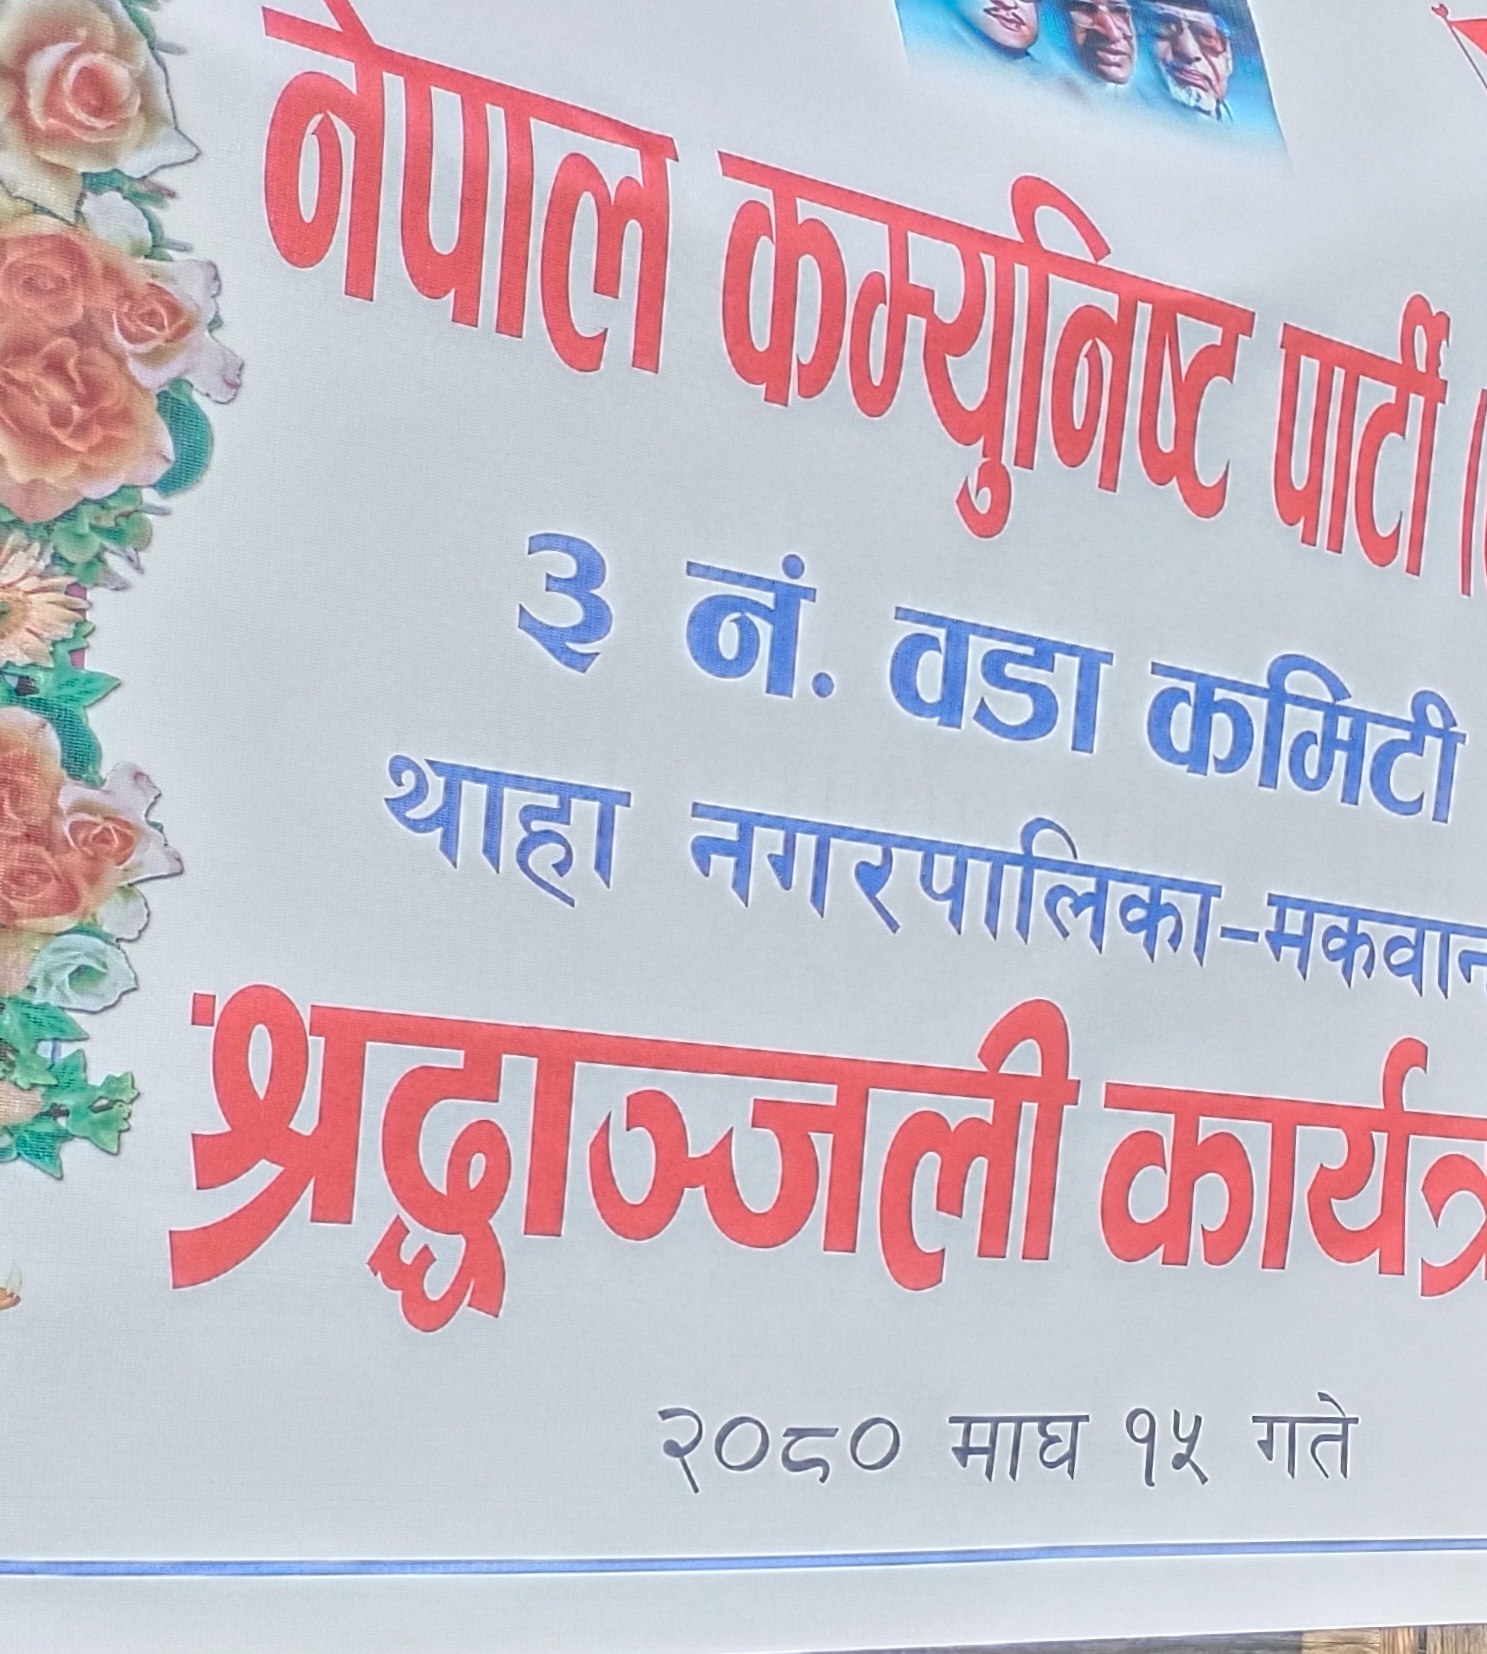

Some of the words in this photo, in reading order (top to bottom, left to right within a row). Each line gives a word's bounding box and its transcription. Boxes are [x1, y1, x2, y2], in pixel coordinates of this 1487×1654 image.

[264, 3, 677, 372] नेपाल
[720, 154, 1254, 538] कम्युनिष्ट
[1273, 293, 1449, 577] पार्टी
[517, 532, 611, 672] ३
[684, 556, 834, 700] नं.
[890, 607, 1114, 753] वडा
[1147, 653, 1465, 825] कमिटी
[384, 754, 630, 906] थाहा
[656, 1404, 903, 1493] २०८०
[949, 1408, 1091, 1484] माघ
[1125, 1408, 1210, 1488] १५
[1252, 1391, 1361, 1482] गते
